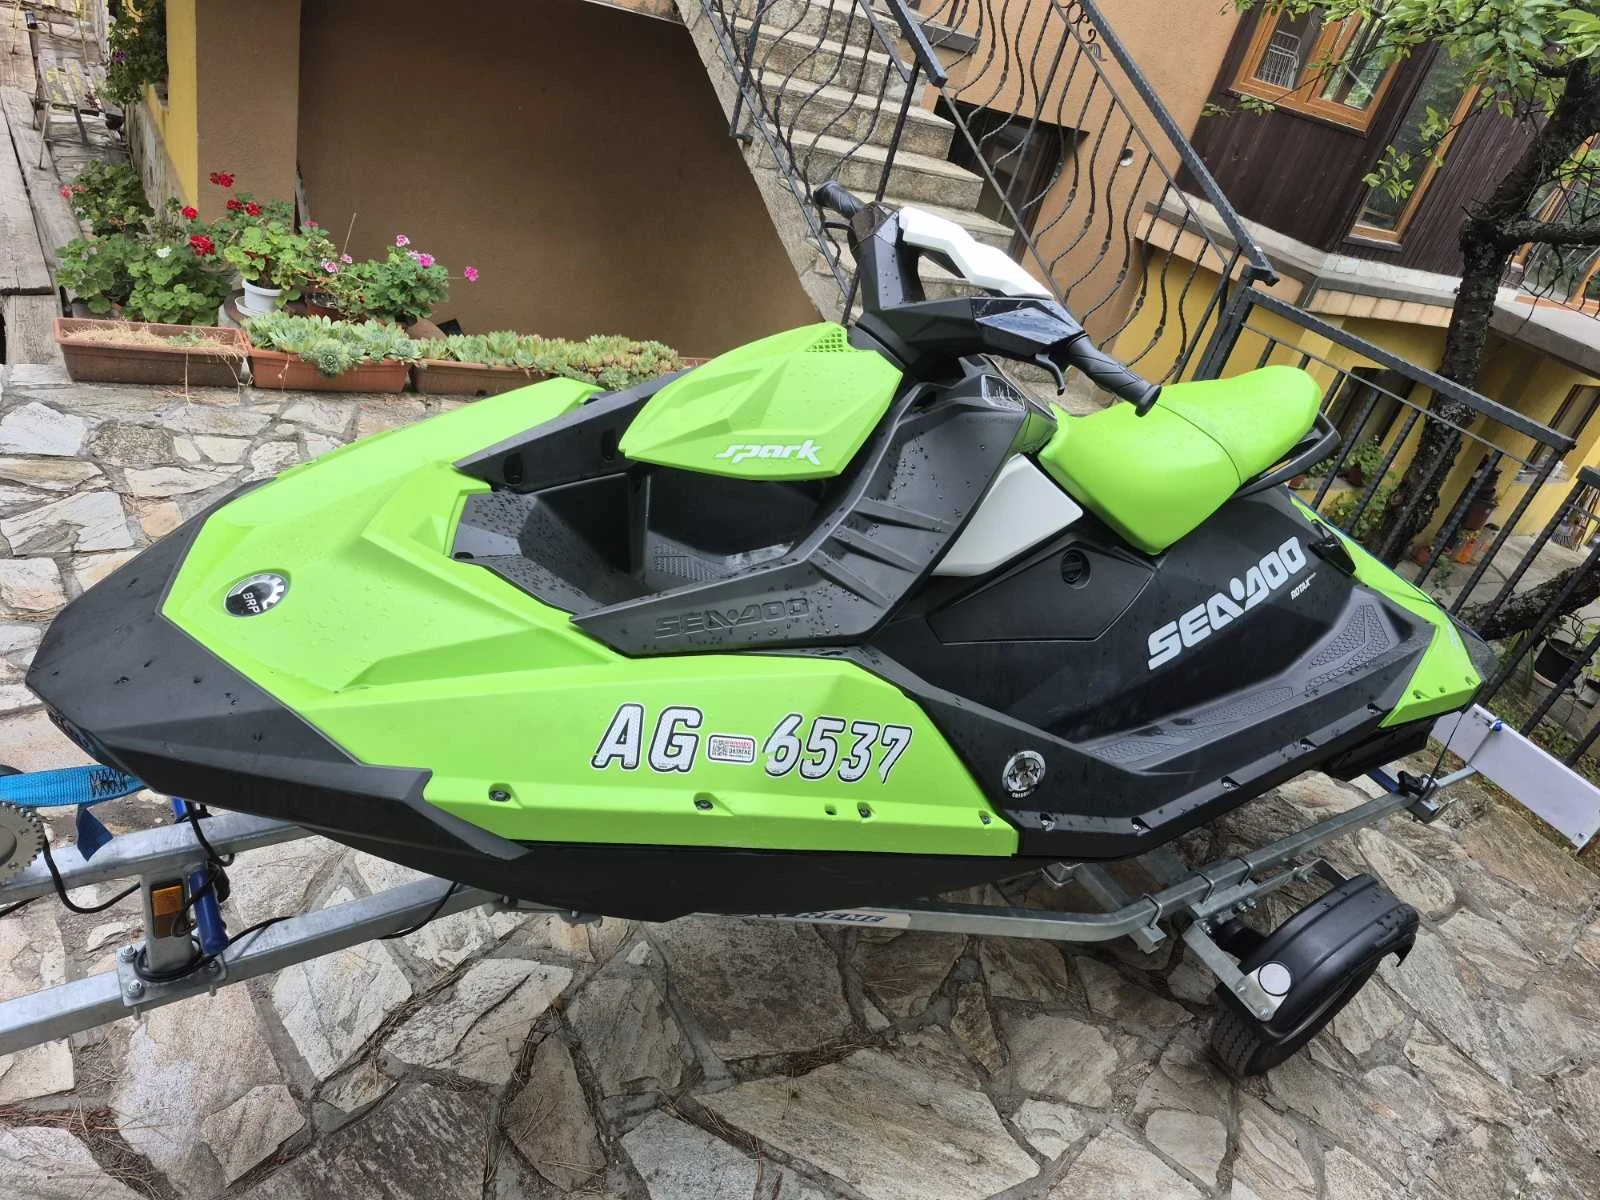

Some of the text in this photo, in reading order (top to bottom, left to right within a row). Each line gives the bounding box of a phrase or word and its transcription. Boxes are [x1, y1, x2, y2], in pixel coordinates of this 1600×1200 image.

[715, 440, 821, 465] spark
[242, 592, 261, 613] BRP
[591, 703, 913, 785] AG 6537
